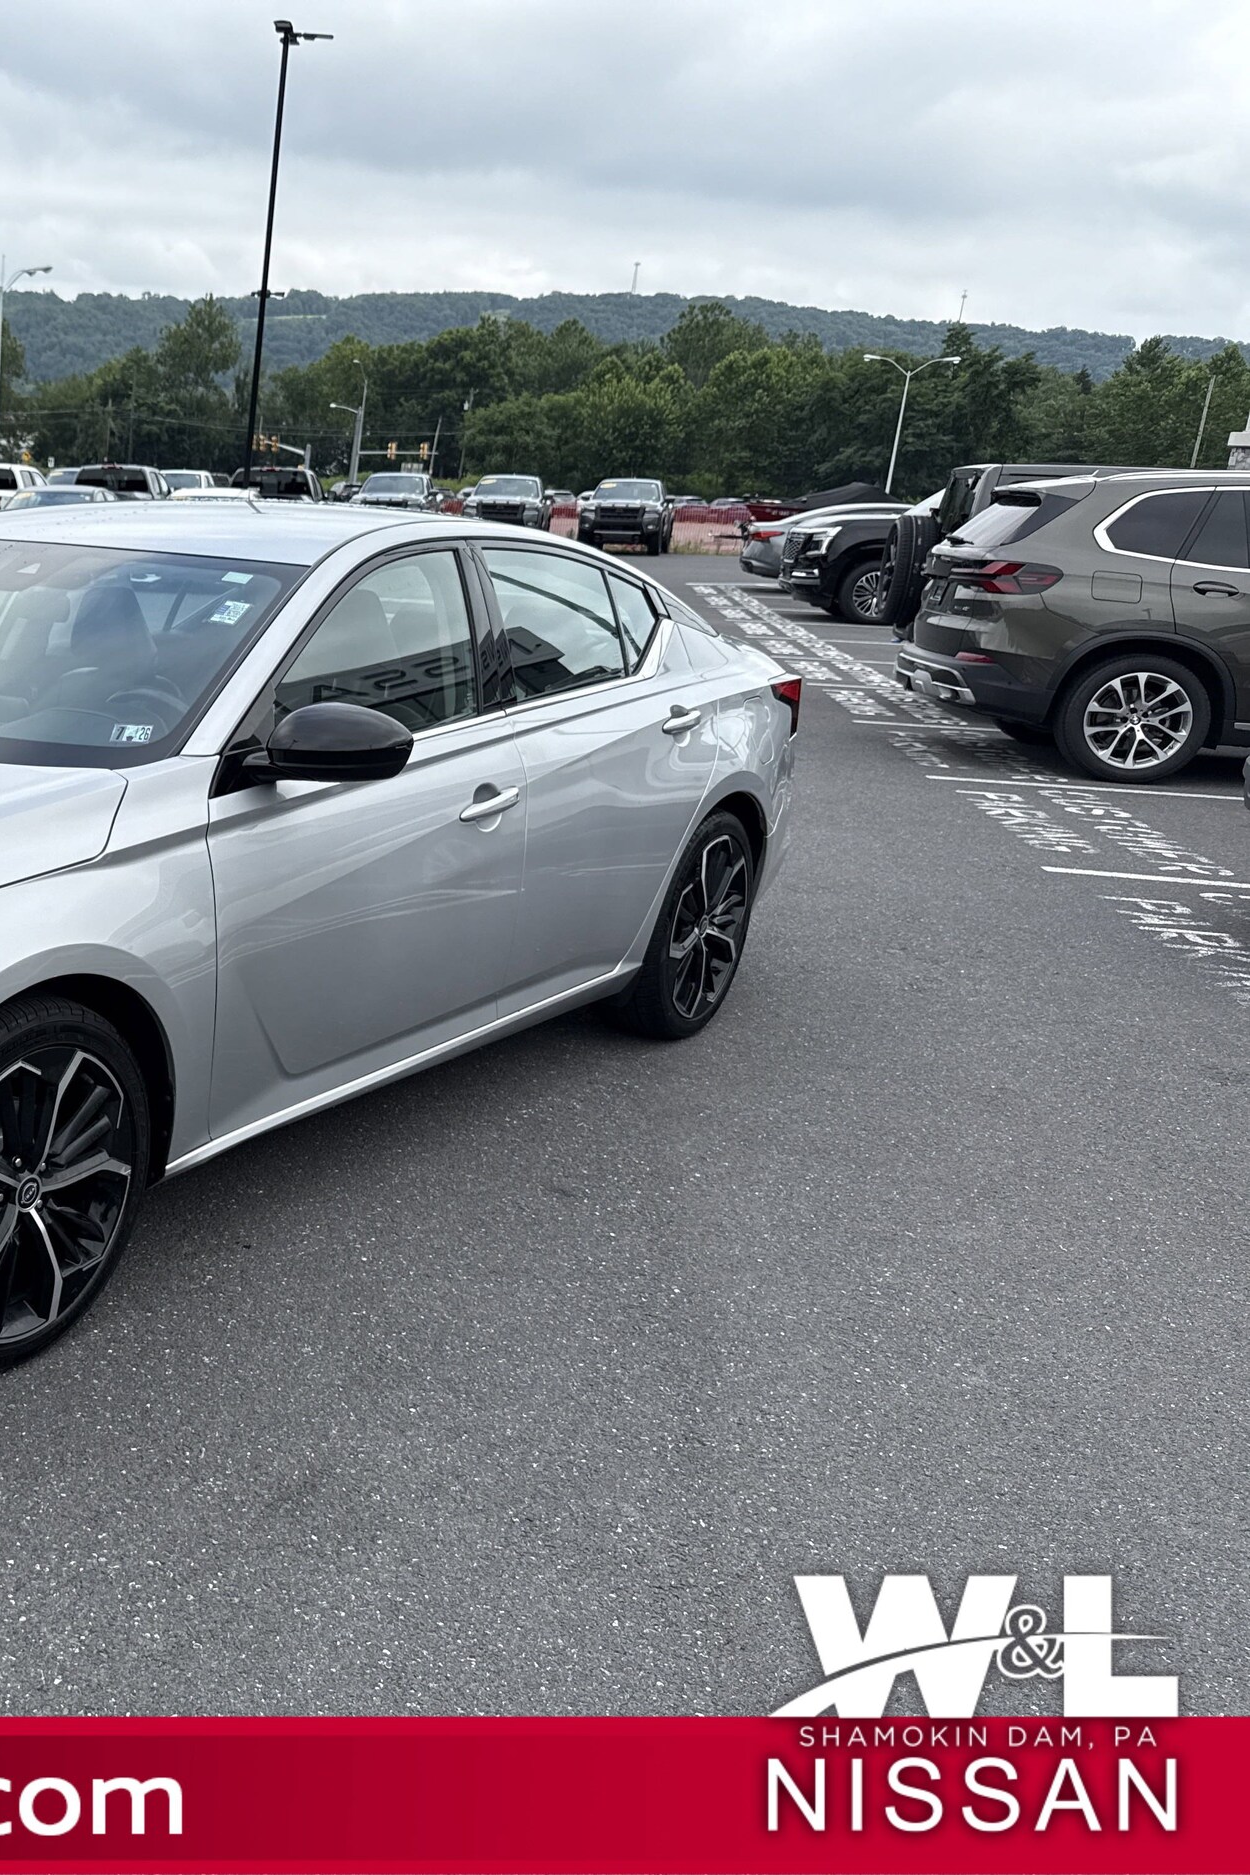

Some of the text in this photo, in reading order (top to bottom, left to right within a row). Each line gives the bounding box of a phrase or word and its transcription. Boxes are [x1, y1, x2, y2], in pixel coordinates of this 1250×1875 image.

[138, 726, 151, 741] 26
[955, 788, 1099, 854] PARKING
[1036, 790, 1235, 877] CUSTOMER
